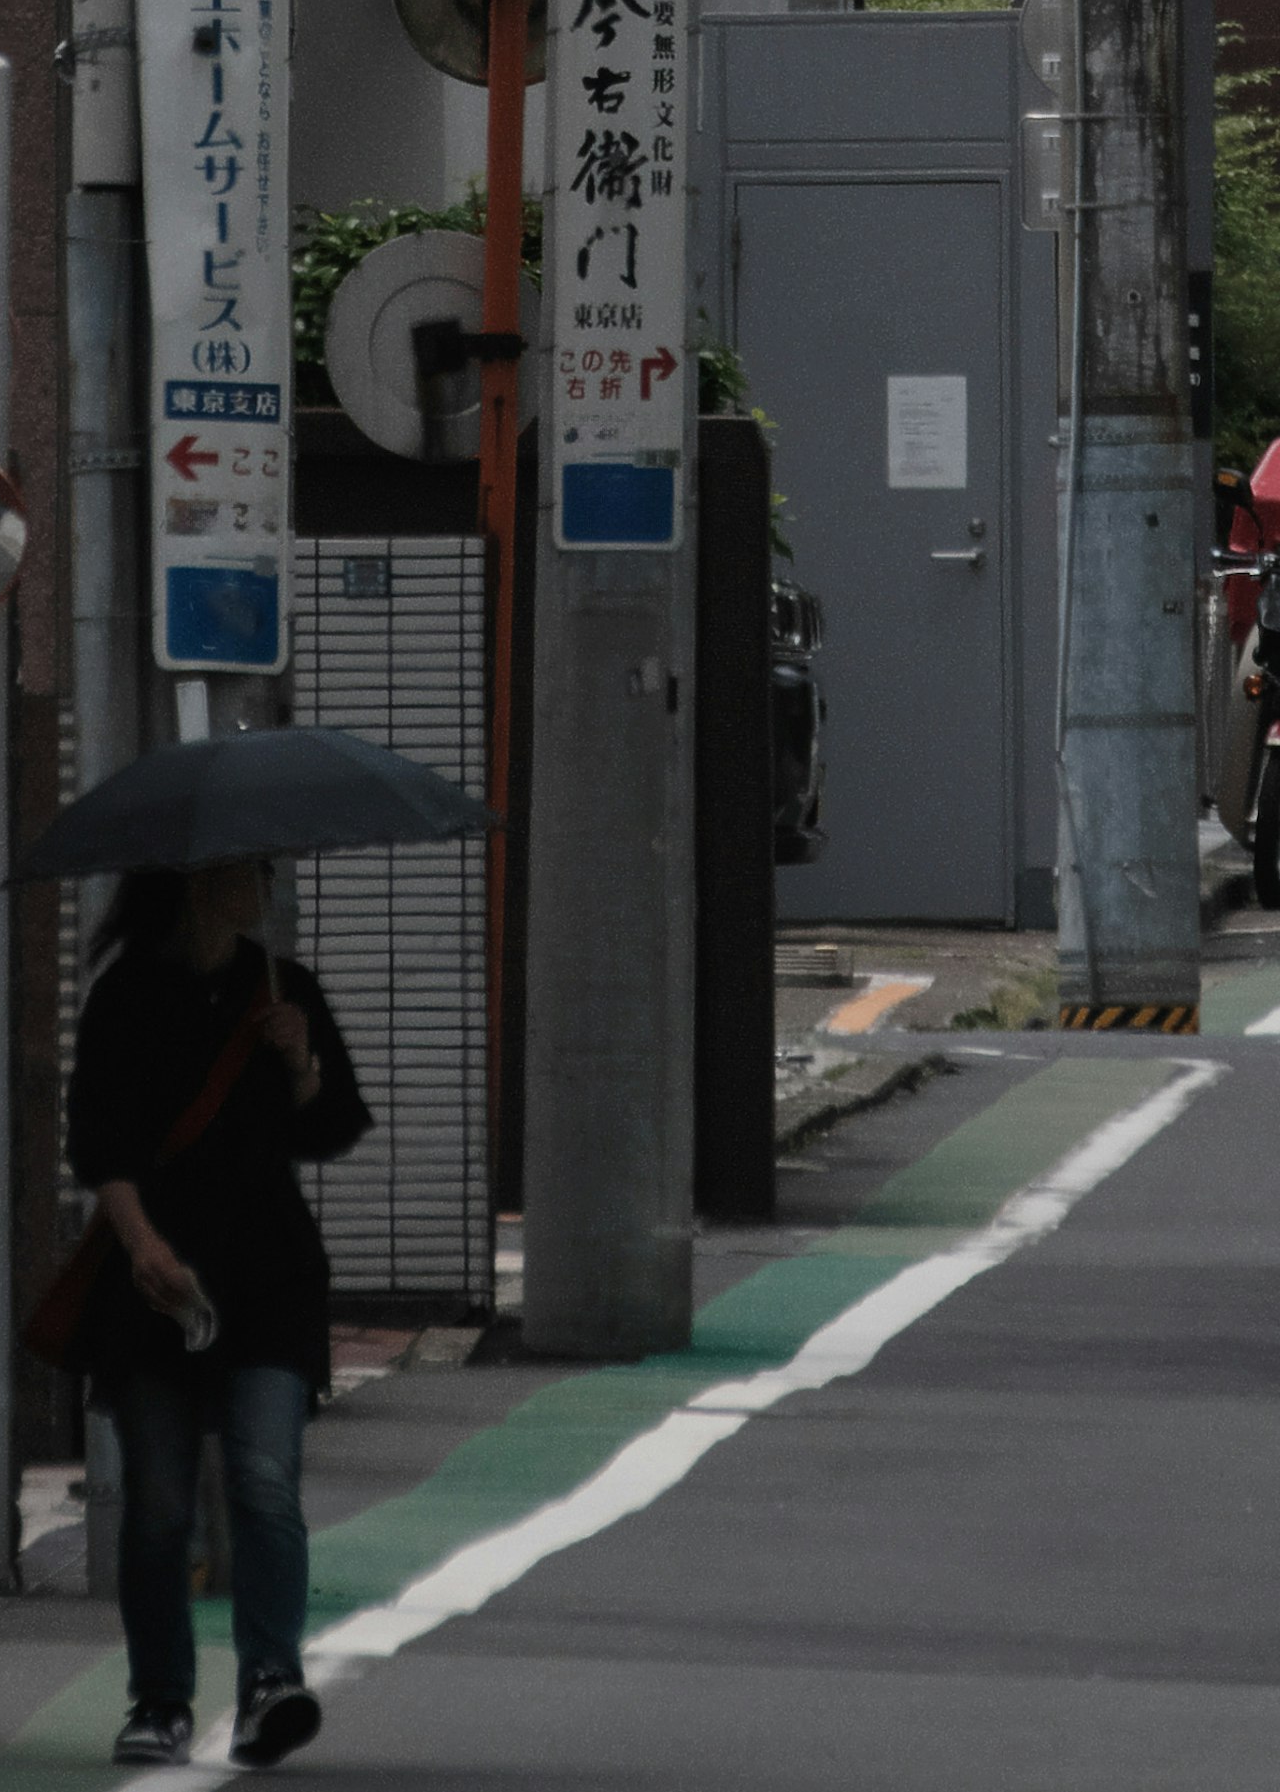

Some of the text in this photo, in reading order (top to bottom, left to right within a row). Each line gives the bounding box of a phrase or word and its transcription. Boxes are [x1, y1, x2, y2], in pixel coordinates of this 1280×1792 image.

[573, 303, 644, 332] 東京店
[560, 348, 633, 375] この先
[566, 375, 624, 402] 右折
[169, 390, 278, 418] 東京支店
